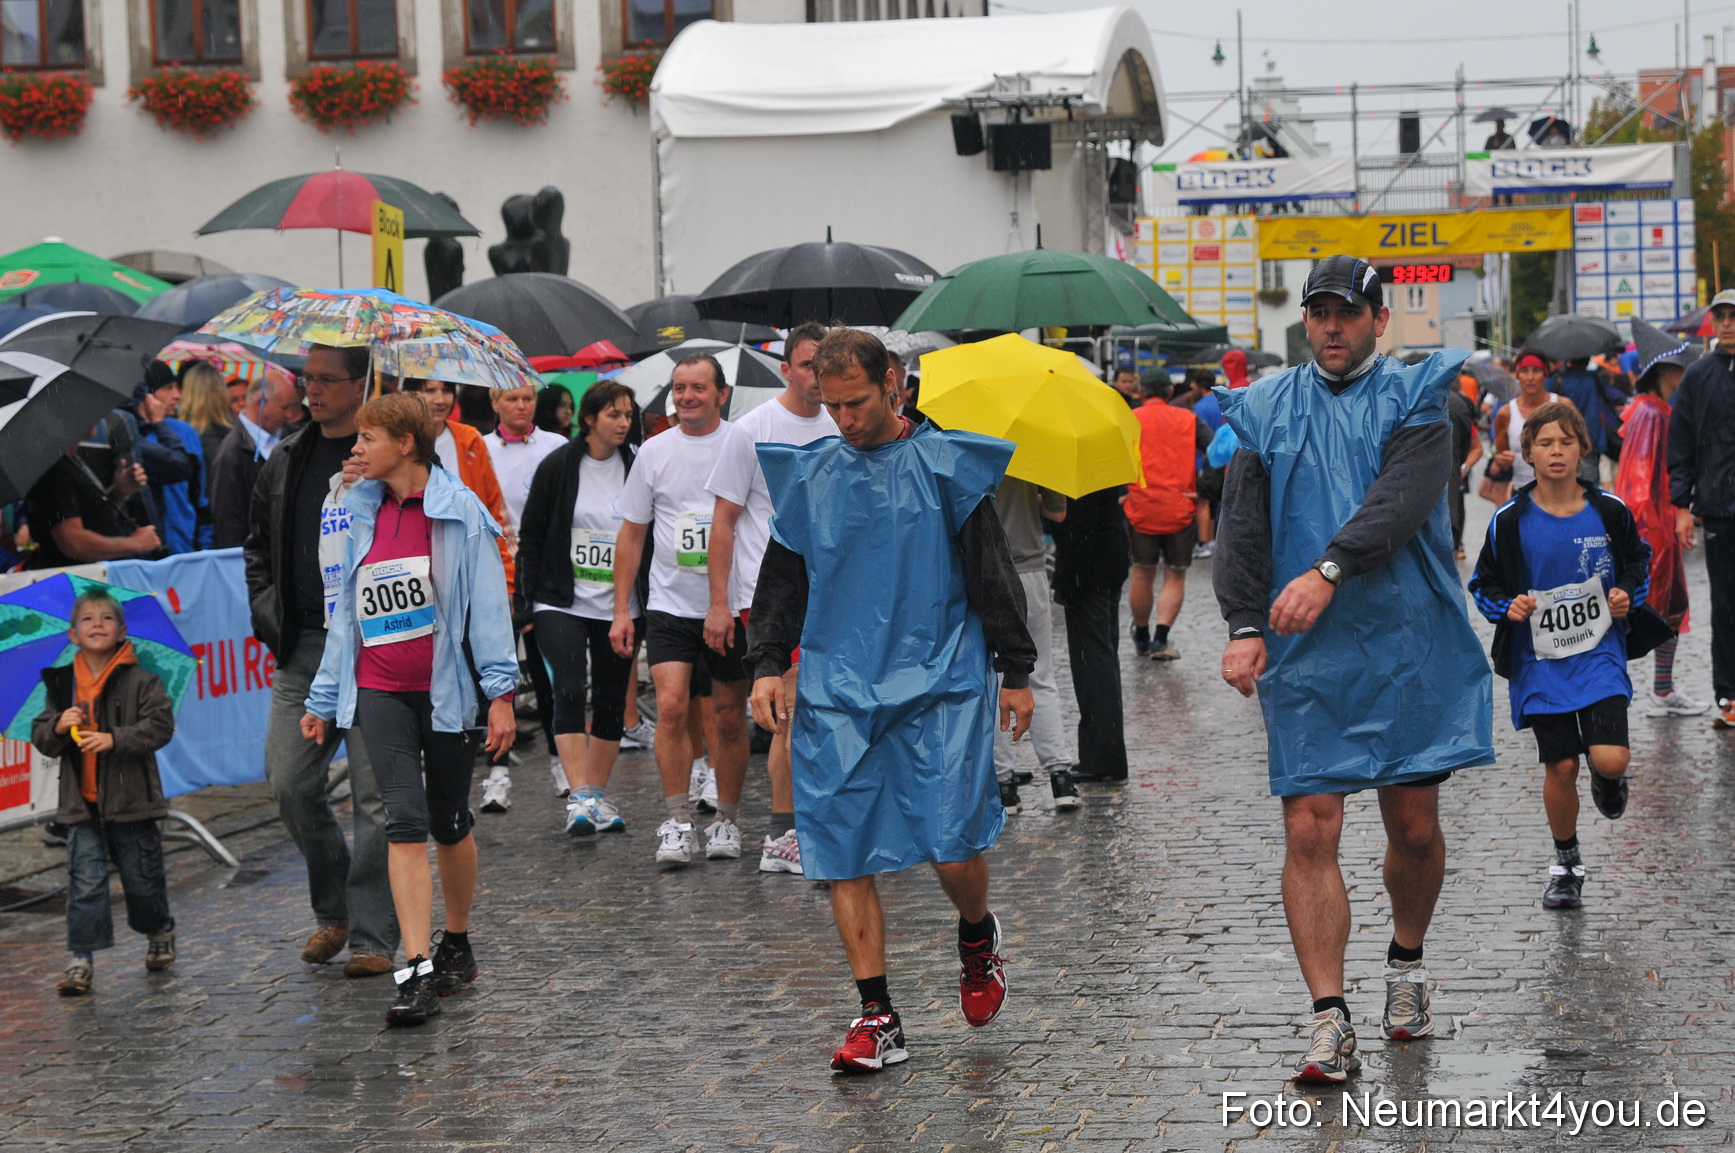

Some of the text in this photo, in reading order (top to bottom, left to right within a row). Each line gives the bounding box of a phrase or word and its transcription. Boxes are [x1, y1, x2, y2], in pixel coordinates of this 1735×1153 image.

[379, 208, 400, 238] Block
[1379, 222, 1449, 247] ZIEL
[362, 578, 426, 616] 3068
[384, 616, 413, 633] Astrid
[1539, 595, 1601, 632] 4086
[1553, 628, 1595, 649] Dominik
[190, 638, 238, 700] TUI
